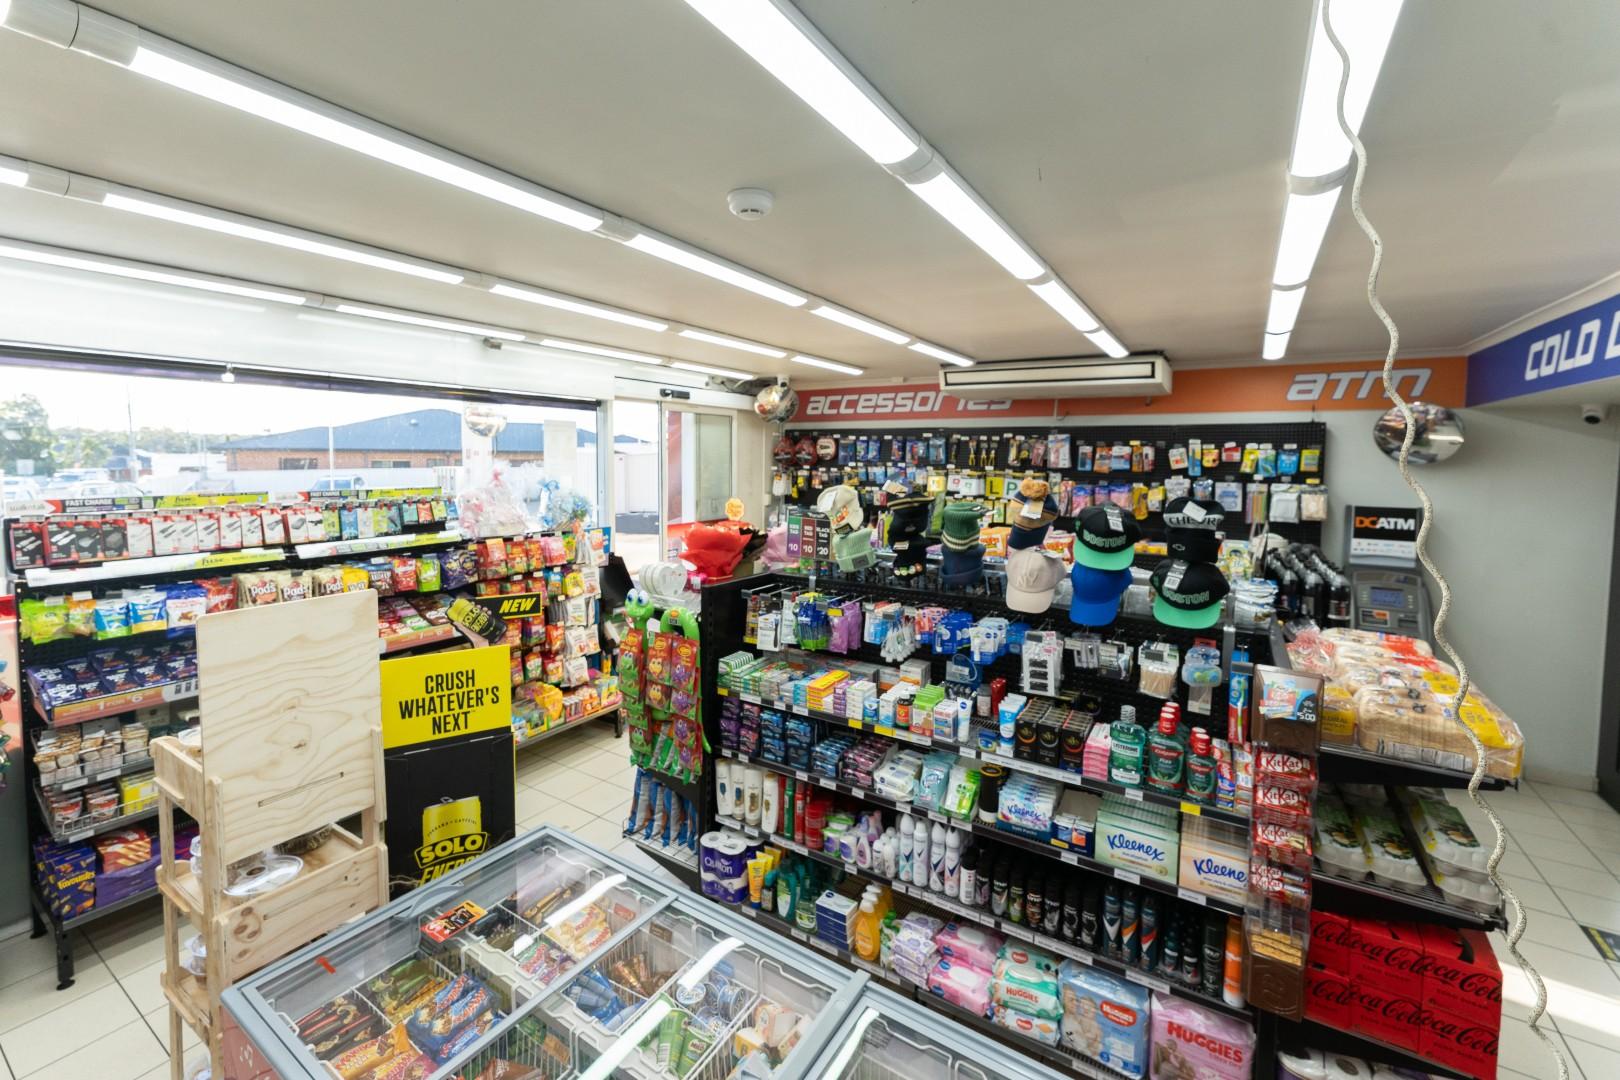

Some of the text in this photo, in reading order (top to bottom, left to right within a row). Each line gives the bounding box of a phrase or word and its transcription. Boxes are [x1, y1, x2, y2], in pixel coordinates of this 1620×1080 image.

[1525, 318, 1601, 381] COLD
[806, 390, 1012, 415] accessories
[988, 480, 999, 495] L
[1355, 516, 1415, 531] DCATM
[1083, 528, 1127, 549] BOSTON
[251, 584, 277, 597] Pods
[499, 597, 537, 614] NEW
[425, 669, 475, 694] CRUSH
[399, 685, 499, 720] WHATEVER'S
[432, 710, 471, 735] NEXT
[420, 834, 483, 863] SOLO
[1107, 833, 1166, 862] Kleenex
[704, 856, 733, 875] Quilton
[1193, 857, 1249, 885] Kleene
[1006, 986, 1039, 1004] HUGGIES
[1167, 1020, 1244, 1064] HUGGIES
